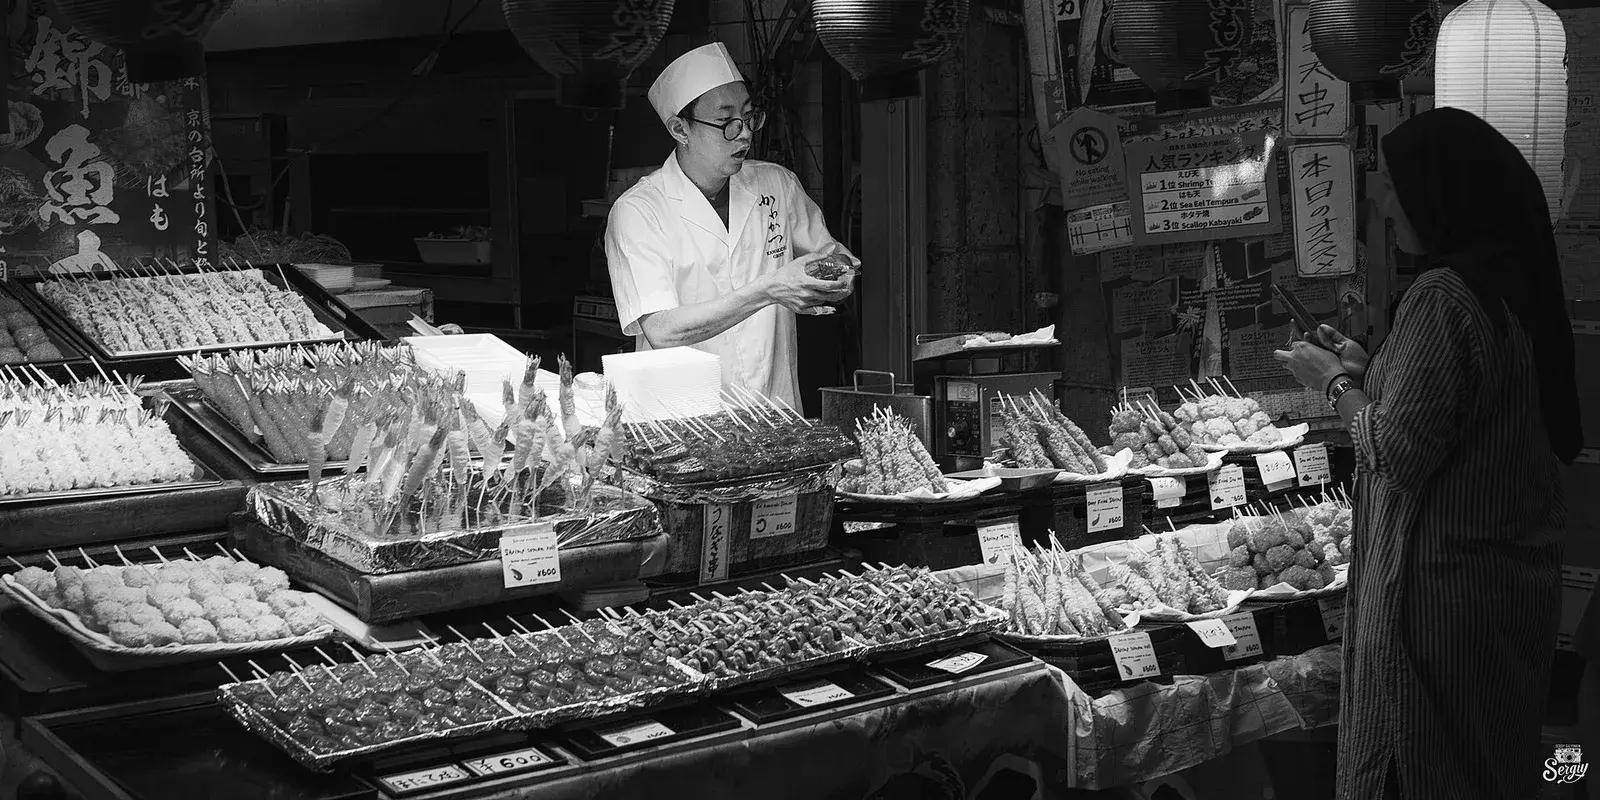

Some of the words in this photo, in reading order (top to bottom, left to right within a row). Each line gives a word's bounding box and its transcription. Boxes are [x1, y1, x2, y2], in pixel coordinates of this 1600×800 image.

[1145, 146, 1256, 171] 人気ランキング
[1075, 169, 1086, 177] No
[1088, 165, 1110, 174] eating
[1160, 179, 1176, 190] 1位
[1178, 180, 1204, 189] Shrimp
[147, 174, 170, 231] はも
[1161, 199, 1178, 210] 2位
[1180, 200, 1193, 209] Sea
[1194, 199, 1205, 208] Eel
[1206, 197, 1239, 208] Tempura
[1301, 152, 1338, 274] 本日のオススメ
[1163, 219, 1179, 230] 3位
[1181, 220, 1207, 230] Scallop
[1208, 216, 1242, 228] Kabayaki
[537, 567, 557, 577] ¥600
